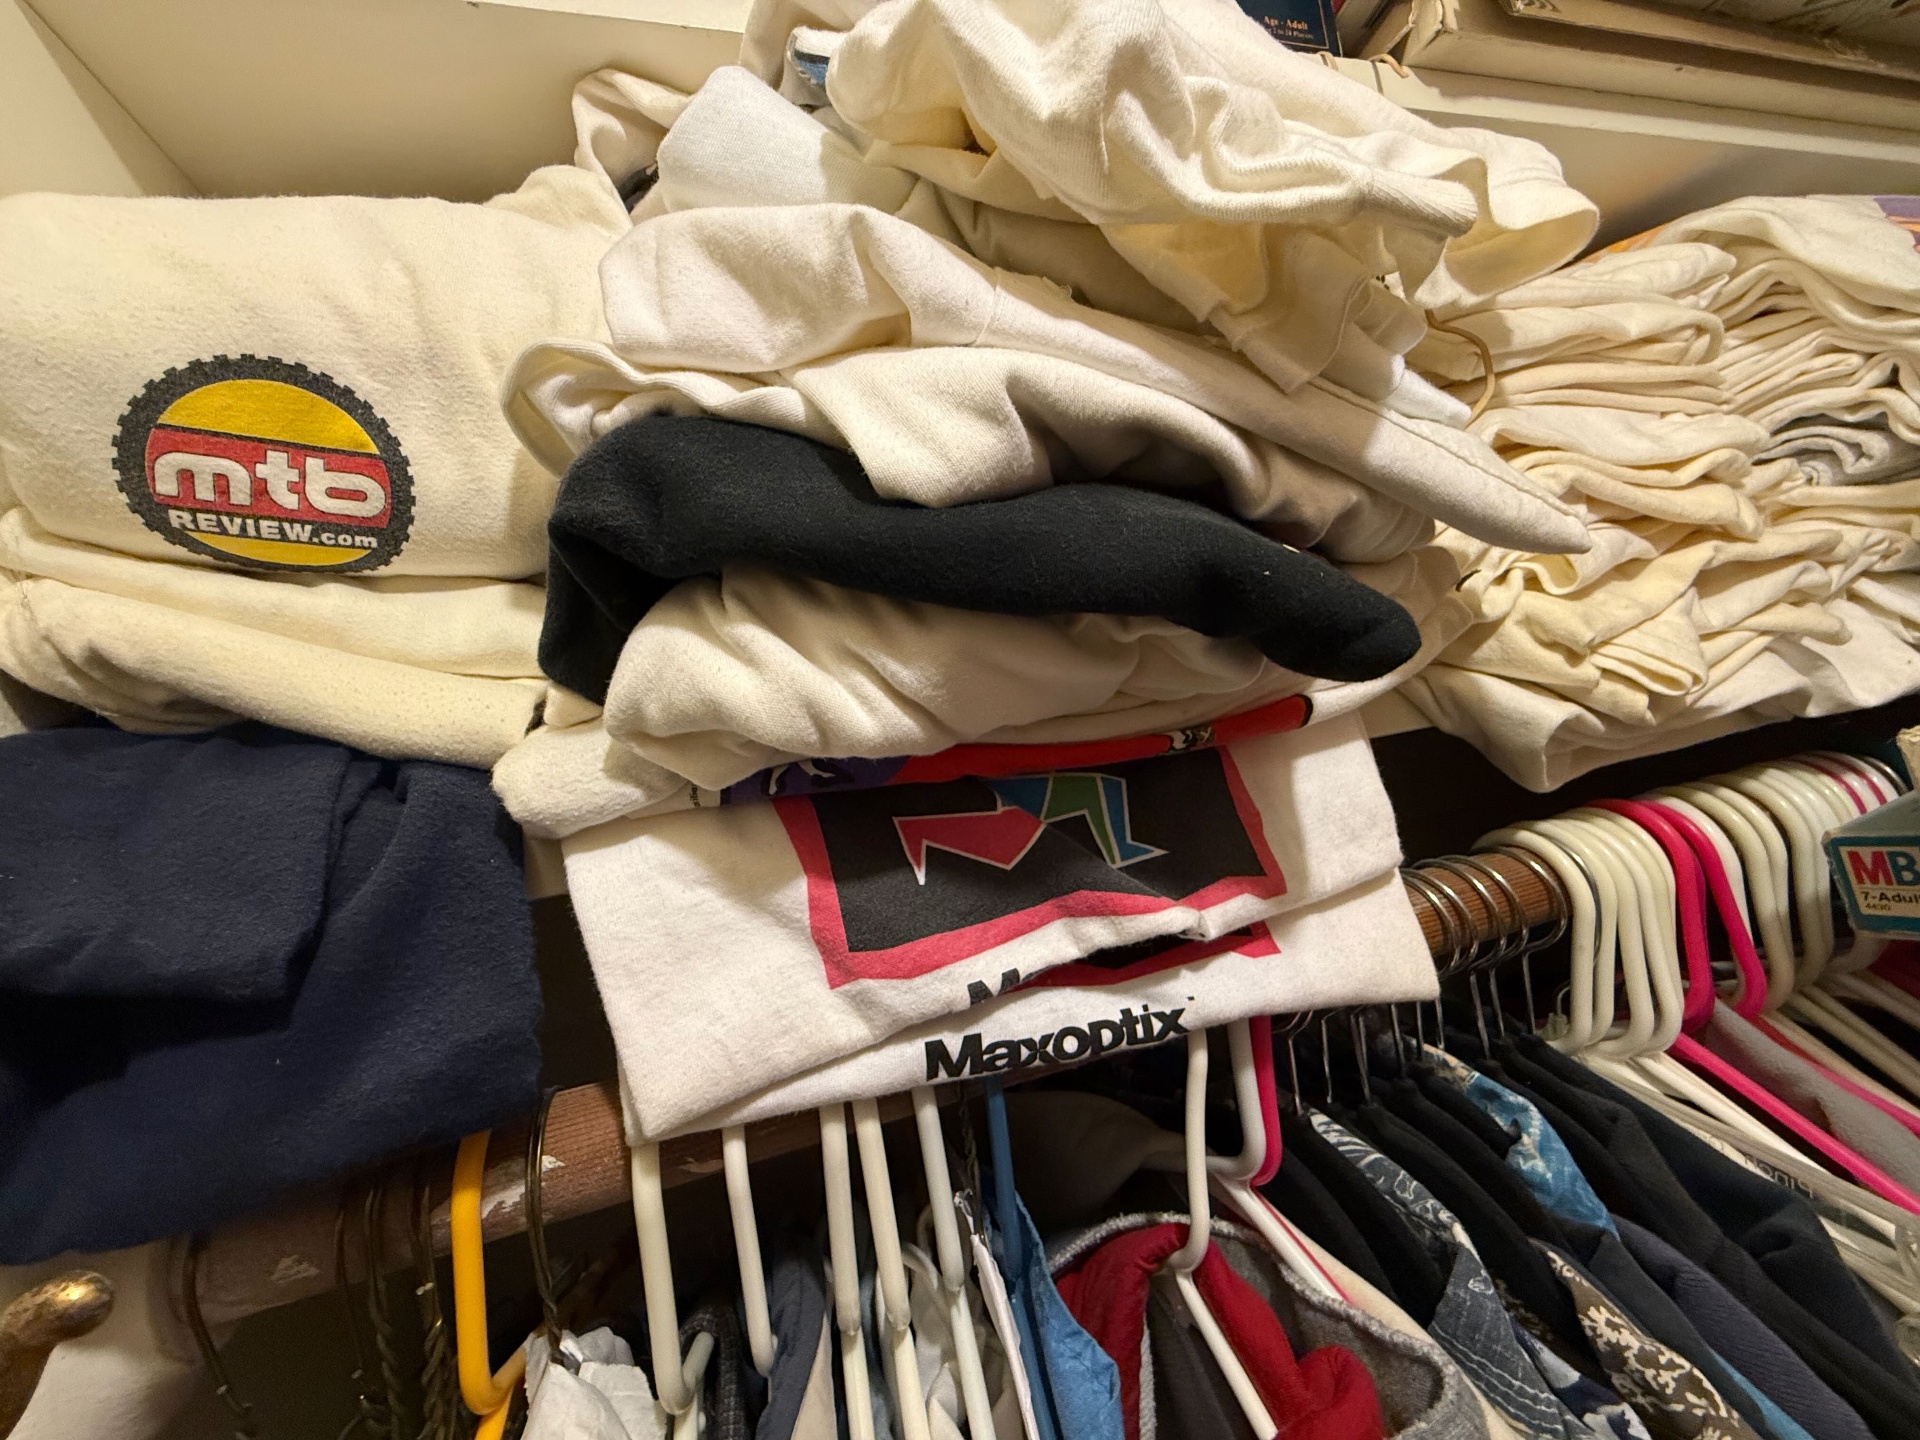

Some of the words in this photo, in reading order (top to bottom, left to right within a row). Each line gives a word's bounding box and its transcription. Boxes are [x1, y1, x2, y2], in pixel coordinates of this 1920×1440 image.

[1264, 15, 1279, 27] Age
[1286, 19, 1308, 30] Adult
[153, 449, 386, 518] mtb
[168, 509, 378, 549] REVIEW.com
[1847, 850, 1920, 886] MB
[1860, 891, 1920, 904] 7-Adul
[925, 1004, 1190, 1082] Maxoptix
